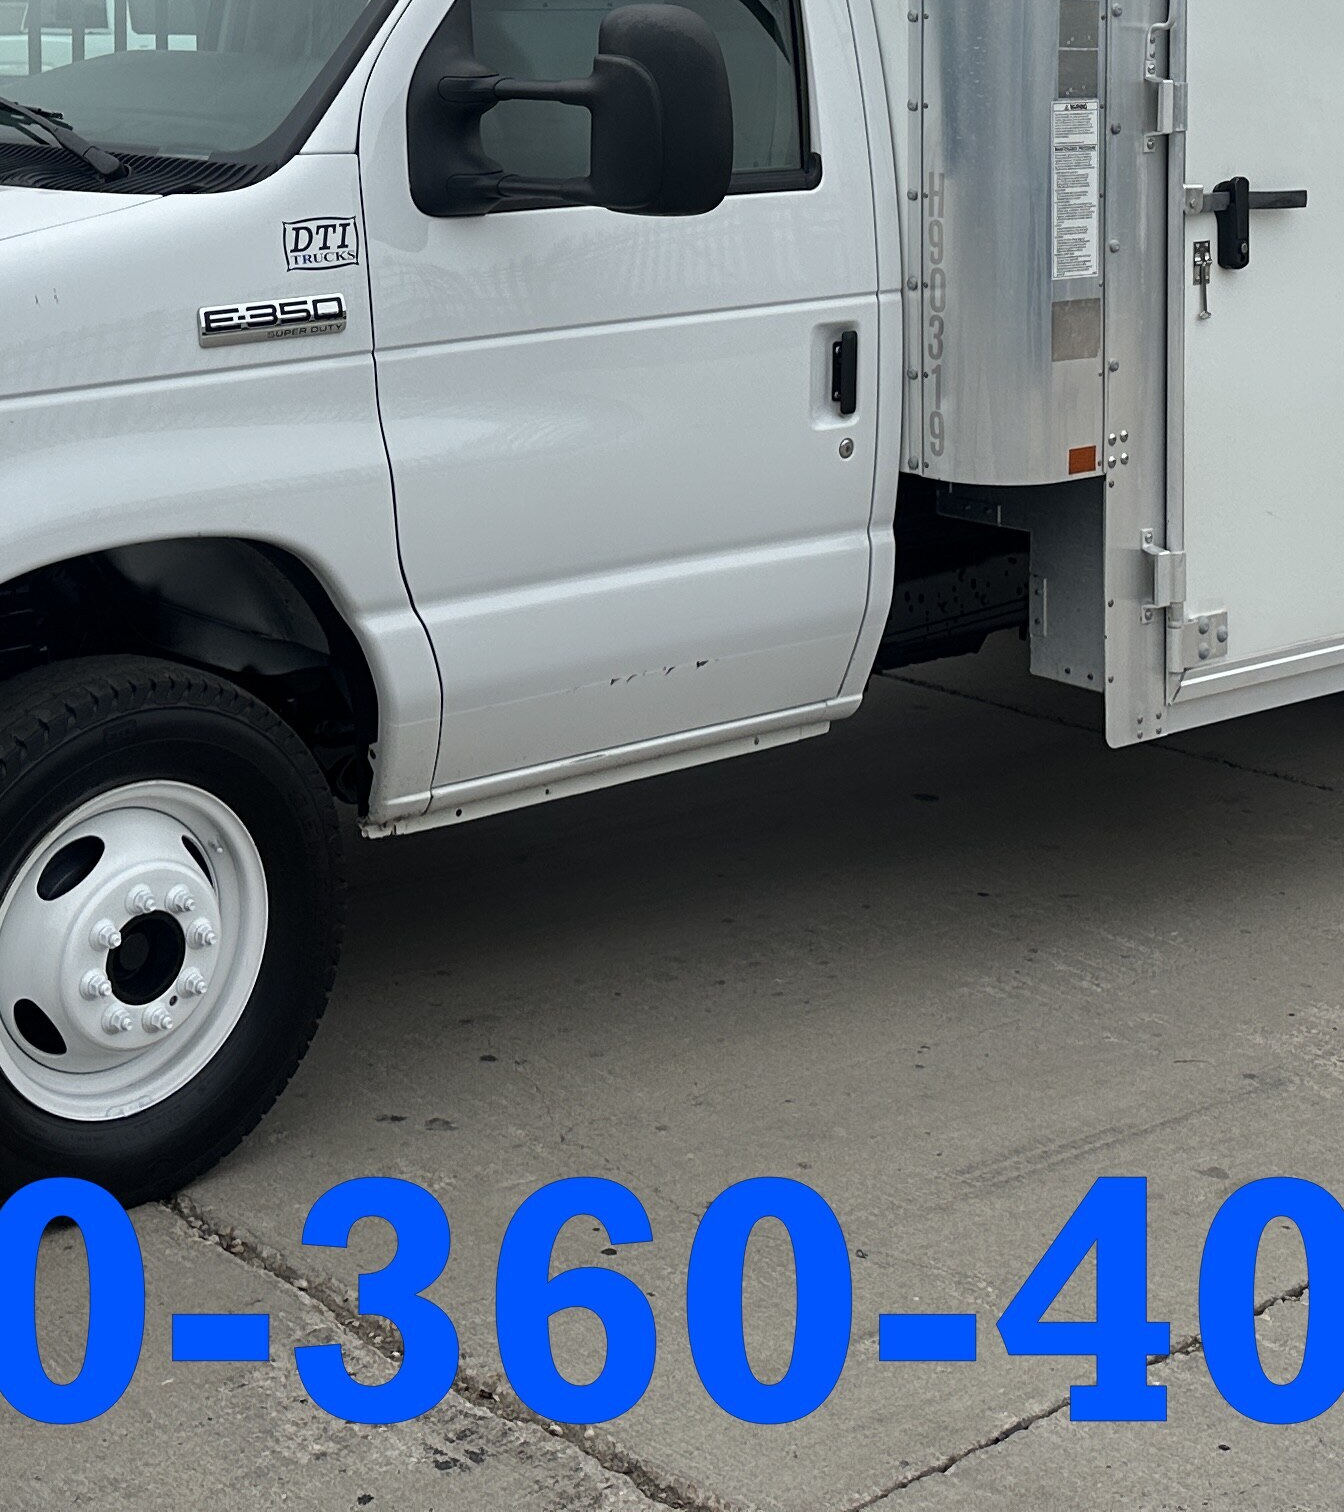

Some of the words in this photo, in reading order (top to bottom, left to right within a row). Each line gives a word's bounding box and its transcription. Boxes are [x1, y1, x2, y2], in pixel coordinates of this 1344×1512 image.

[290, 222, 351, 253] DTI
[291, 250, 356, 265] TRUCKS
[203, 296, 344, 333] E-350
[267, 327, 307, 338] SUPER
[310, 323, 344, 334] DUTY
